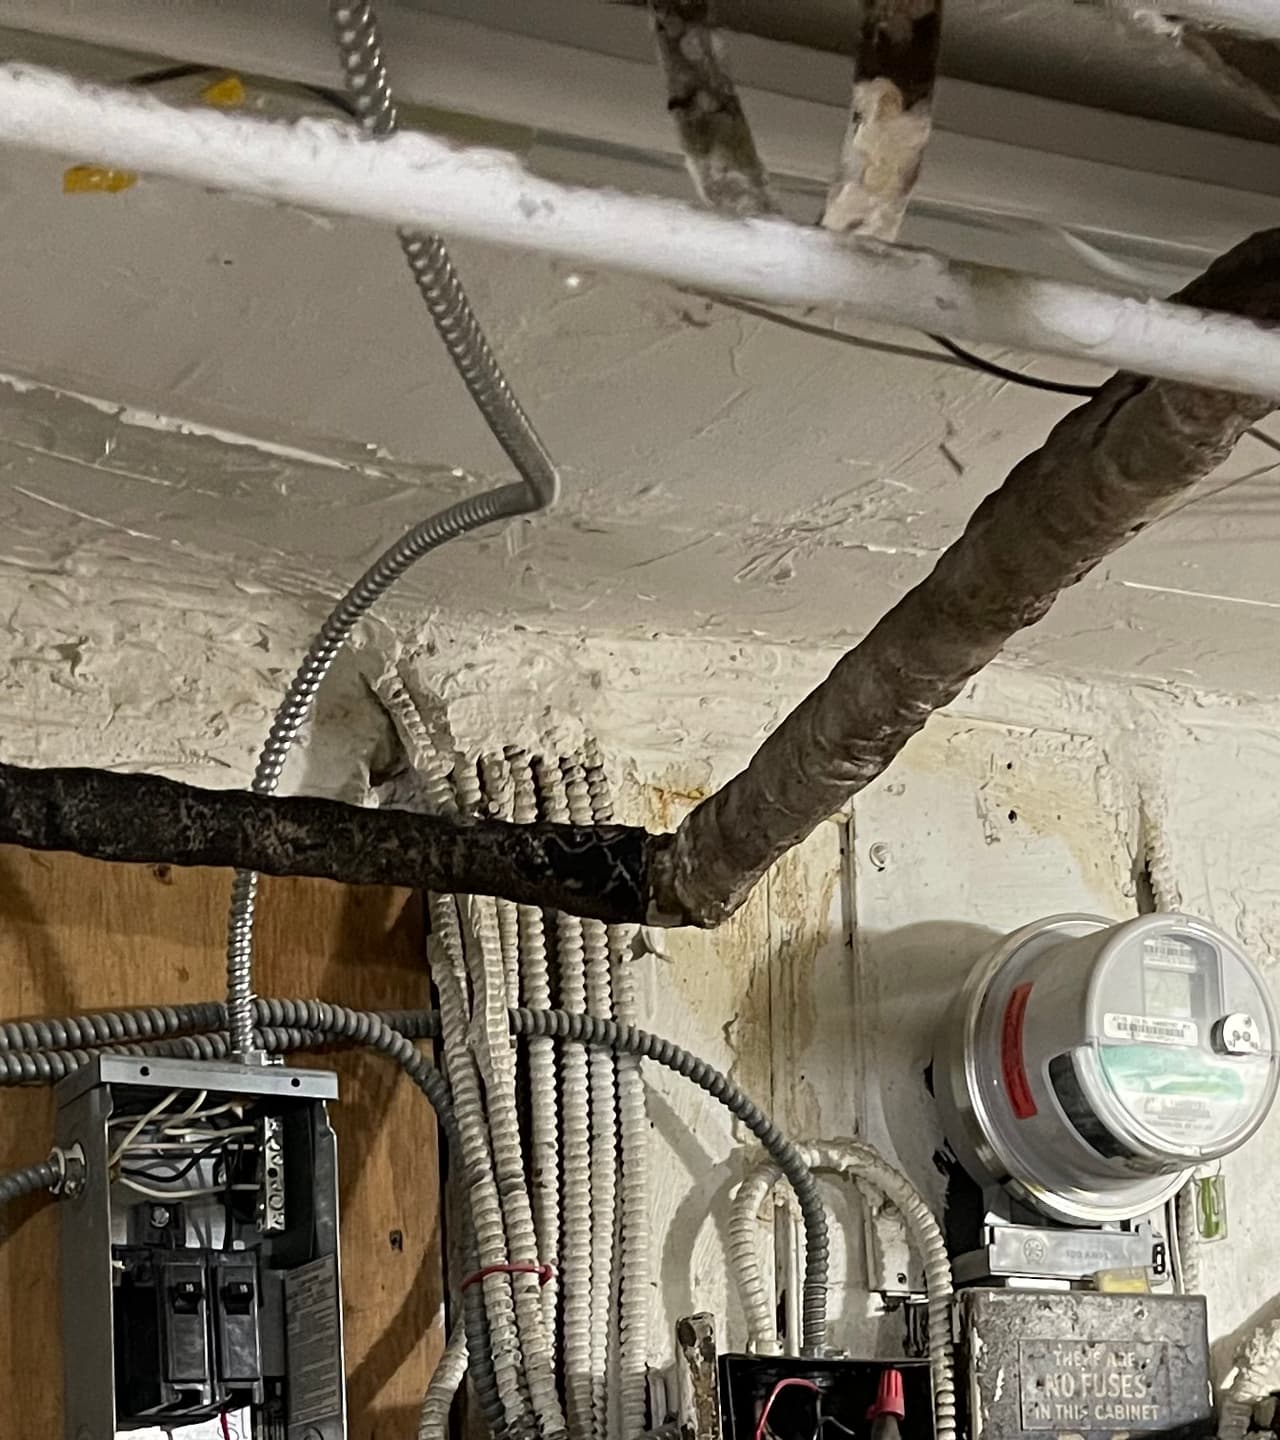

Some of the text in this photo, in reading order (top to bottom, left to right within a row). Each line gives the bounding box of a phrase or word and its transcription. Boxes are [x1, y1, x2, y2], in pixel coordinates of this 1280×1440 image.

[1045, 1373, 1147, 1399] NO FUSES
[1034, 1405, 1051, 1420] IN
[1094, 1405, 1160, 1421] CABINET
